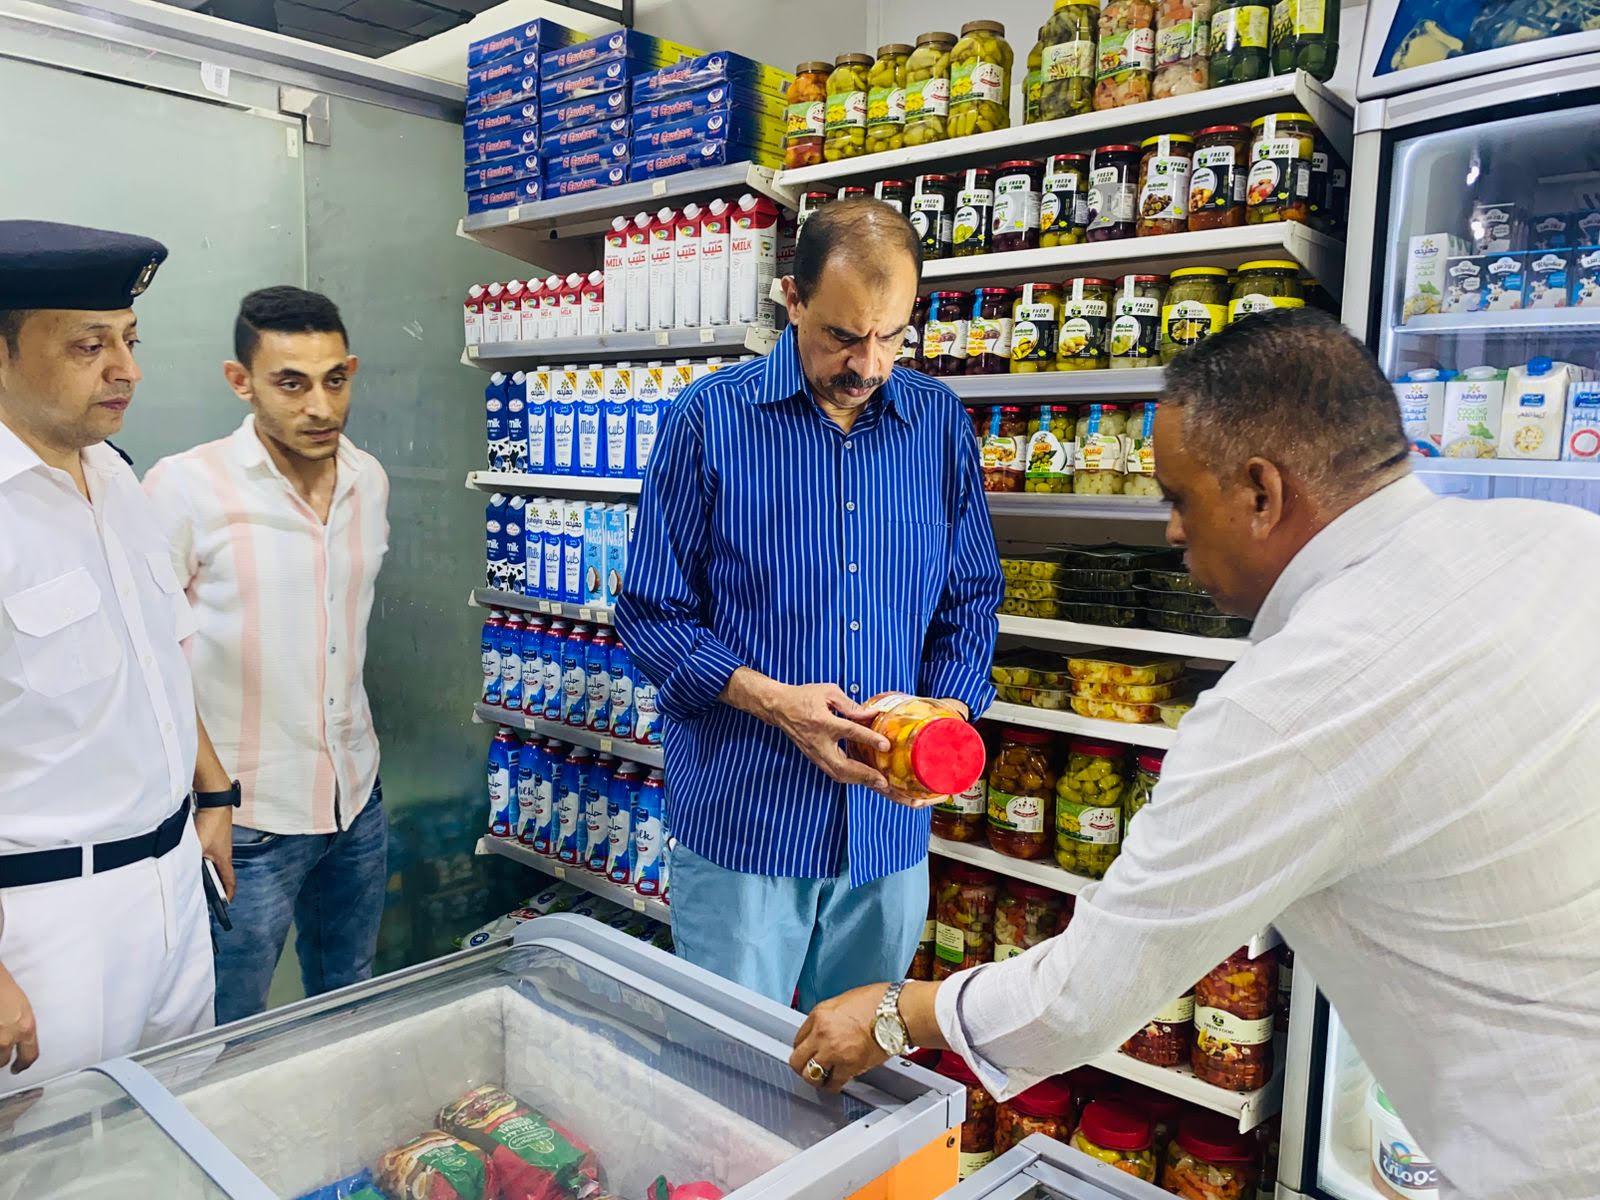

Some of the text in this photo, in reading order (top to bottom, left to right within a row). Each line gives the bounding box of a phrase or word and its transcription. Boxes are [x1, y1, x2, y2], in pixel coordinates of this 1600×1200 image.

[703, 244, 722, 256] حليب
[732, 241, 752, 251] MILK
[652, 251, 670, 262] حليب
[677, 248, 696, 259] حليب
[606, 258, 622, 267] MILK
[628, 255, 646, 266] حليب
[501, 660, 515, 671] حلي
[523, 663, 540, 675] حلي
[566, 673, 579, 685] حلي
[588, 677, 604, 690] حلي
[610, 682, 626, 695] حلي
[637, 830, 654, 840] ilk
